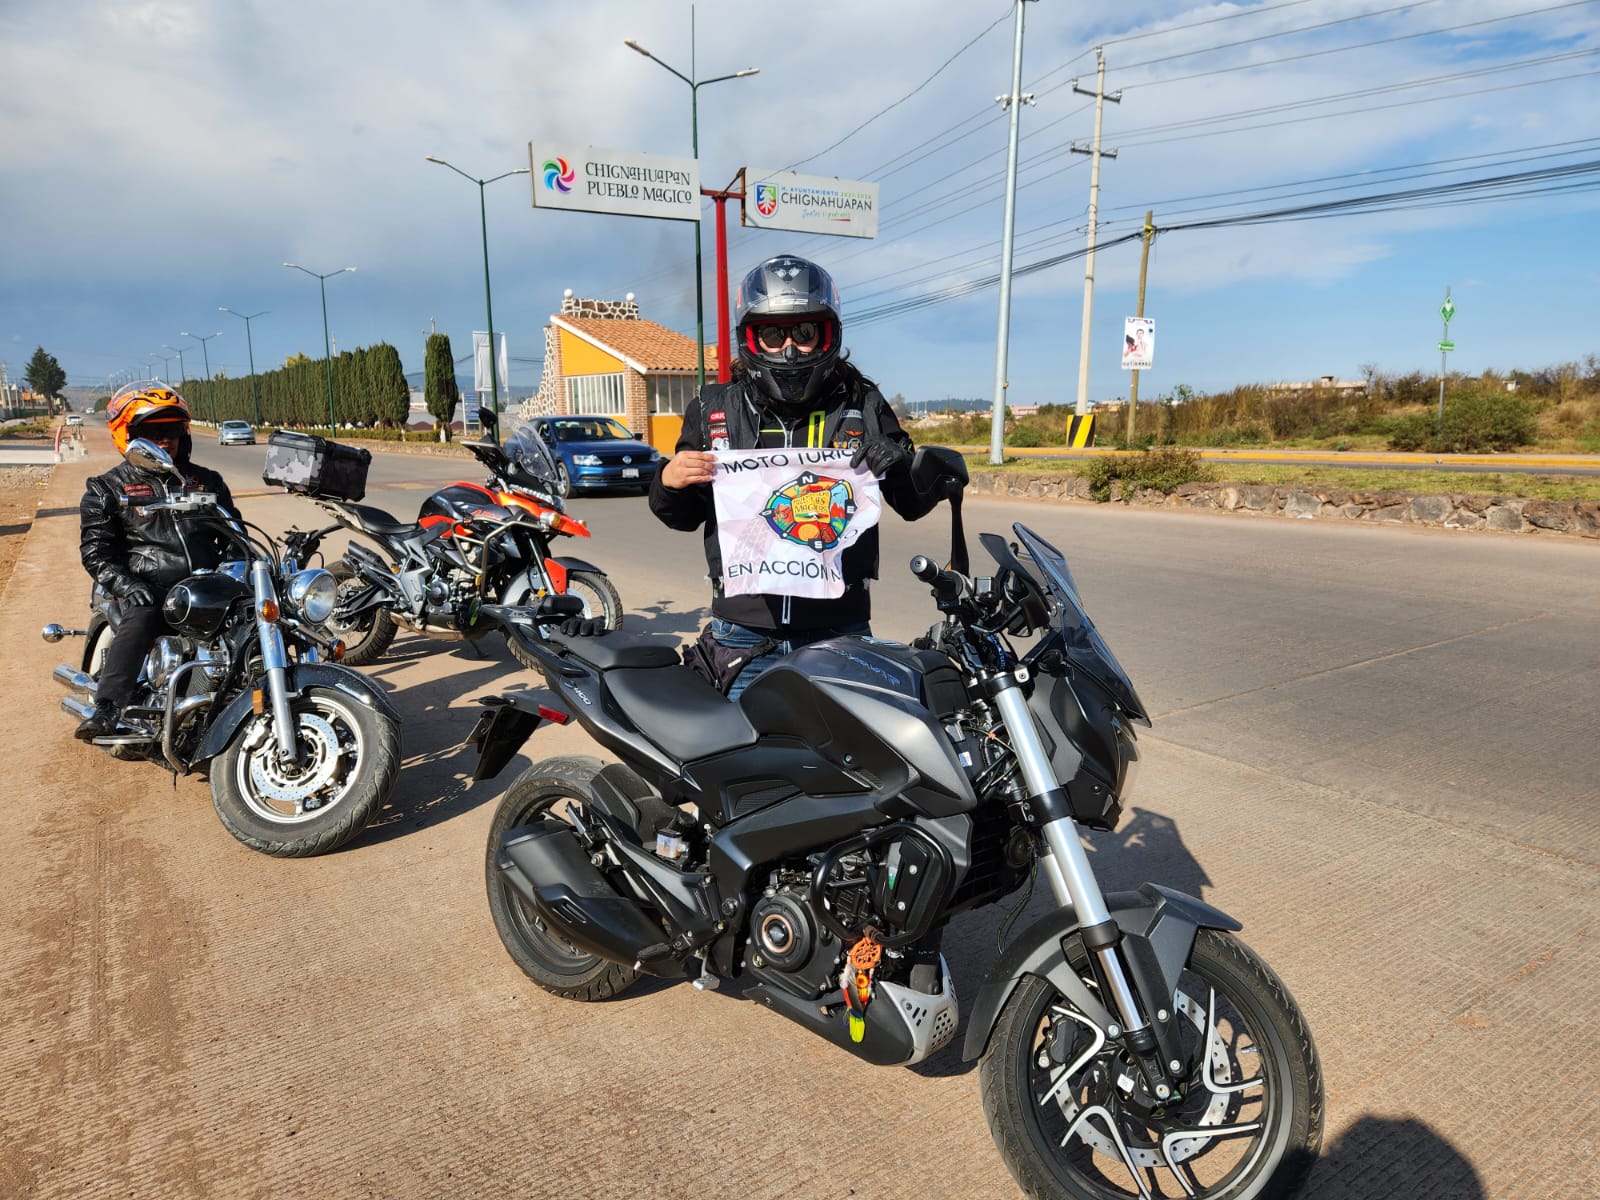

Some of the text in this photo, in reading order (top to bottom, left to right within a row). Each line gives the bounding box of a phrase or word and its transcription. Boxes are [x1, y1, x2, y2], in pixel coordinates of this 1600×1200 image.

[781, 192, 872, 211] CHIGNAHUAPAN
[722, 454, 789, 474] MOTO
[802, 475, 813, 484] N
[728, 562, 753, 578] EN
[759, 558, 829, 581] ACCIÓN
